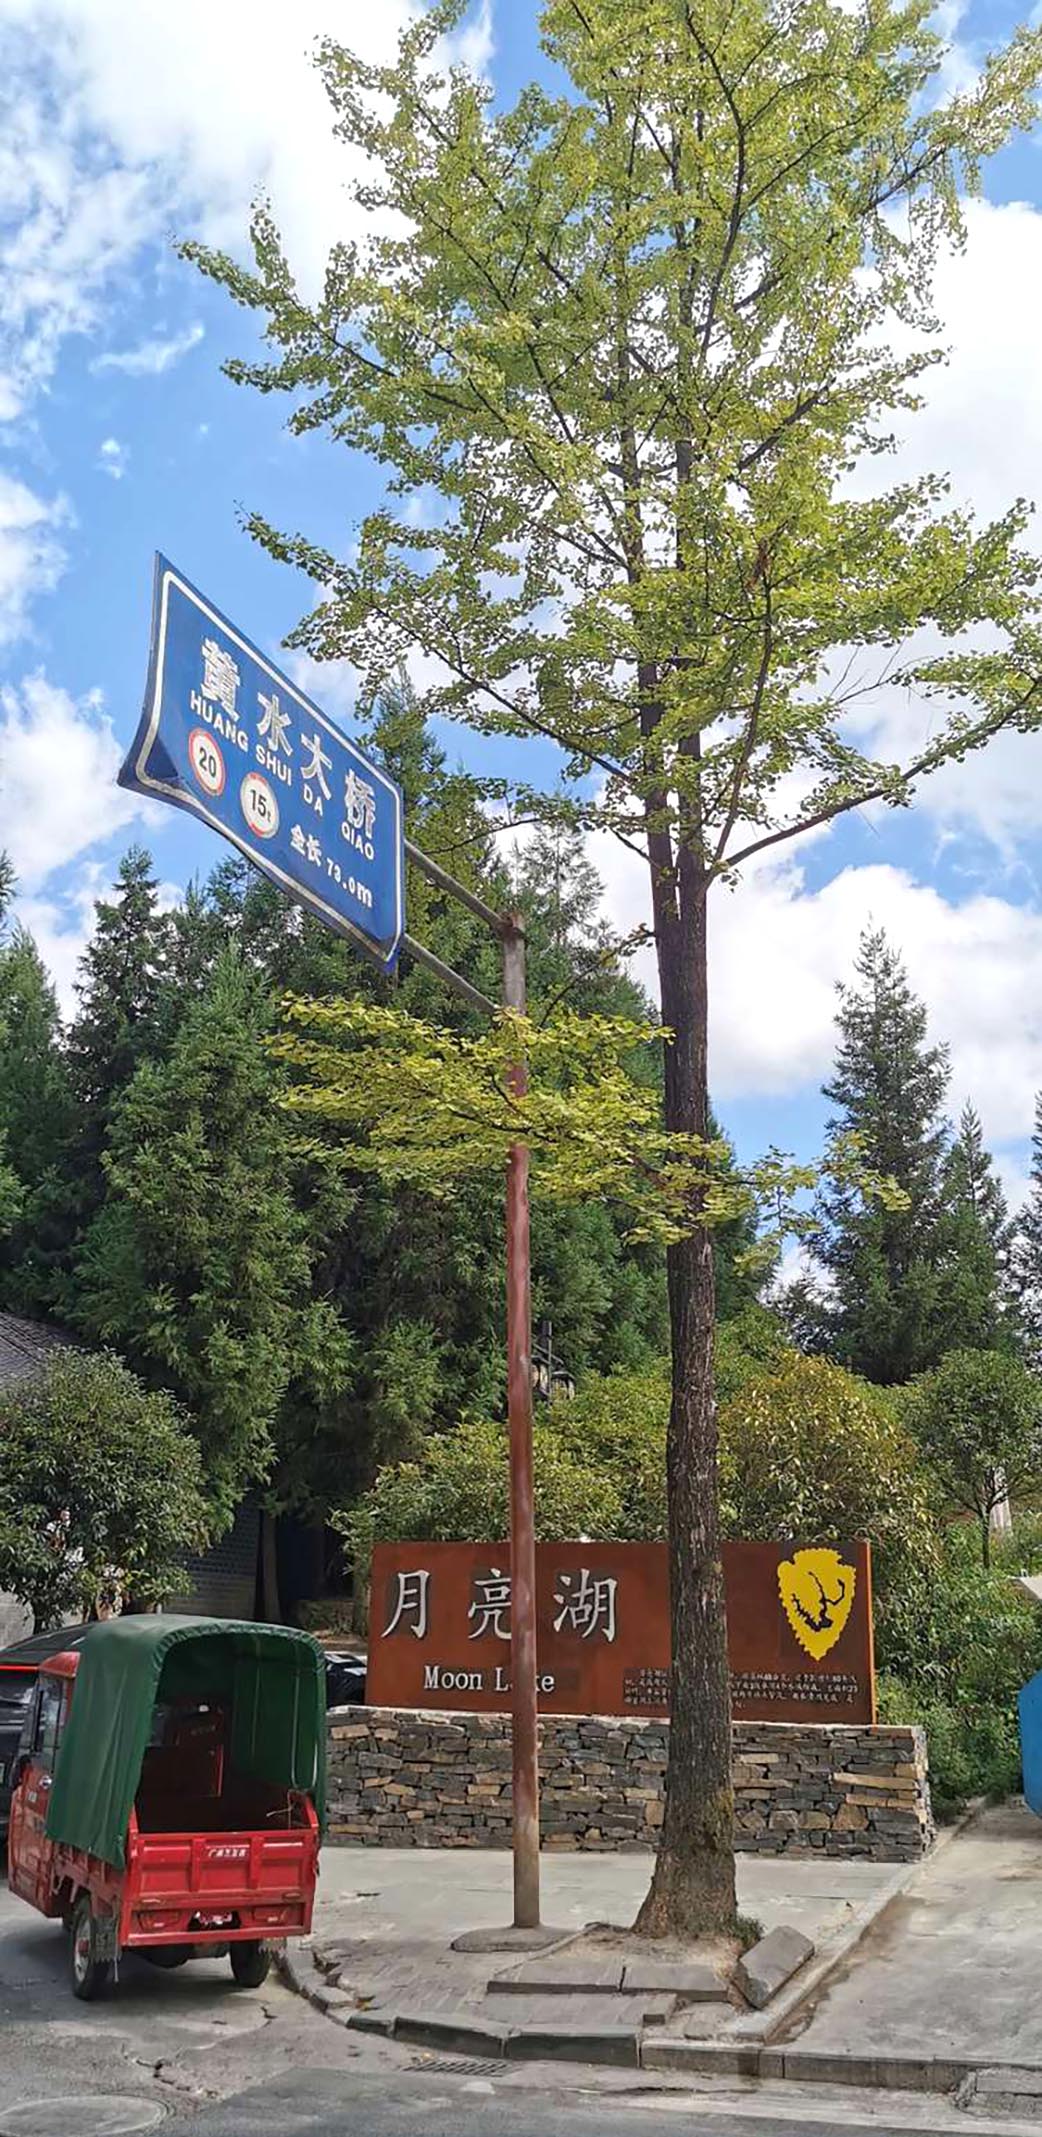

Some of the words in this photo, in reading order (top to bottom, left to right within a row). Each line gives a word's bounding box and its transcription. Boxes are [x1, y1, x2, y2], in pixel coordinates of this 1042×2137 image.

[190, 690, 249, 752] HUANG
[256, 744, 292, 787] SHUI
[303, 783, 323, 817] DA
[341, 821, 375, 860] QIAO
[199, 747, 217, 778] 20
[290, 824, 322, 868] 全长
[326, 857, 373, 908] 73.0m
[380, 1567, 618, 1643] 月亮湖
[424, 1665, 483, 1690] Moon
[495, 1667, 555, 1692] Le
